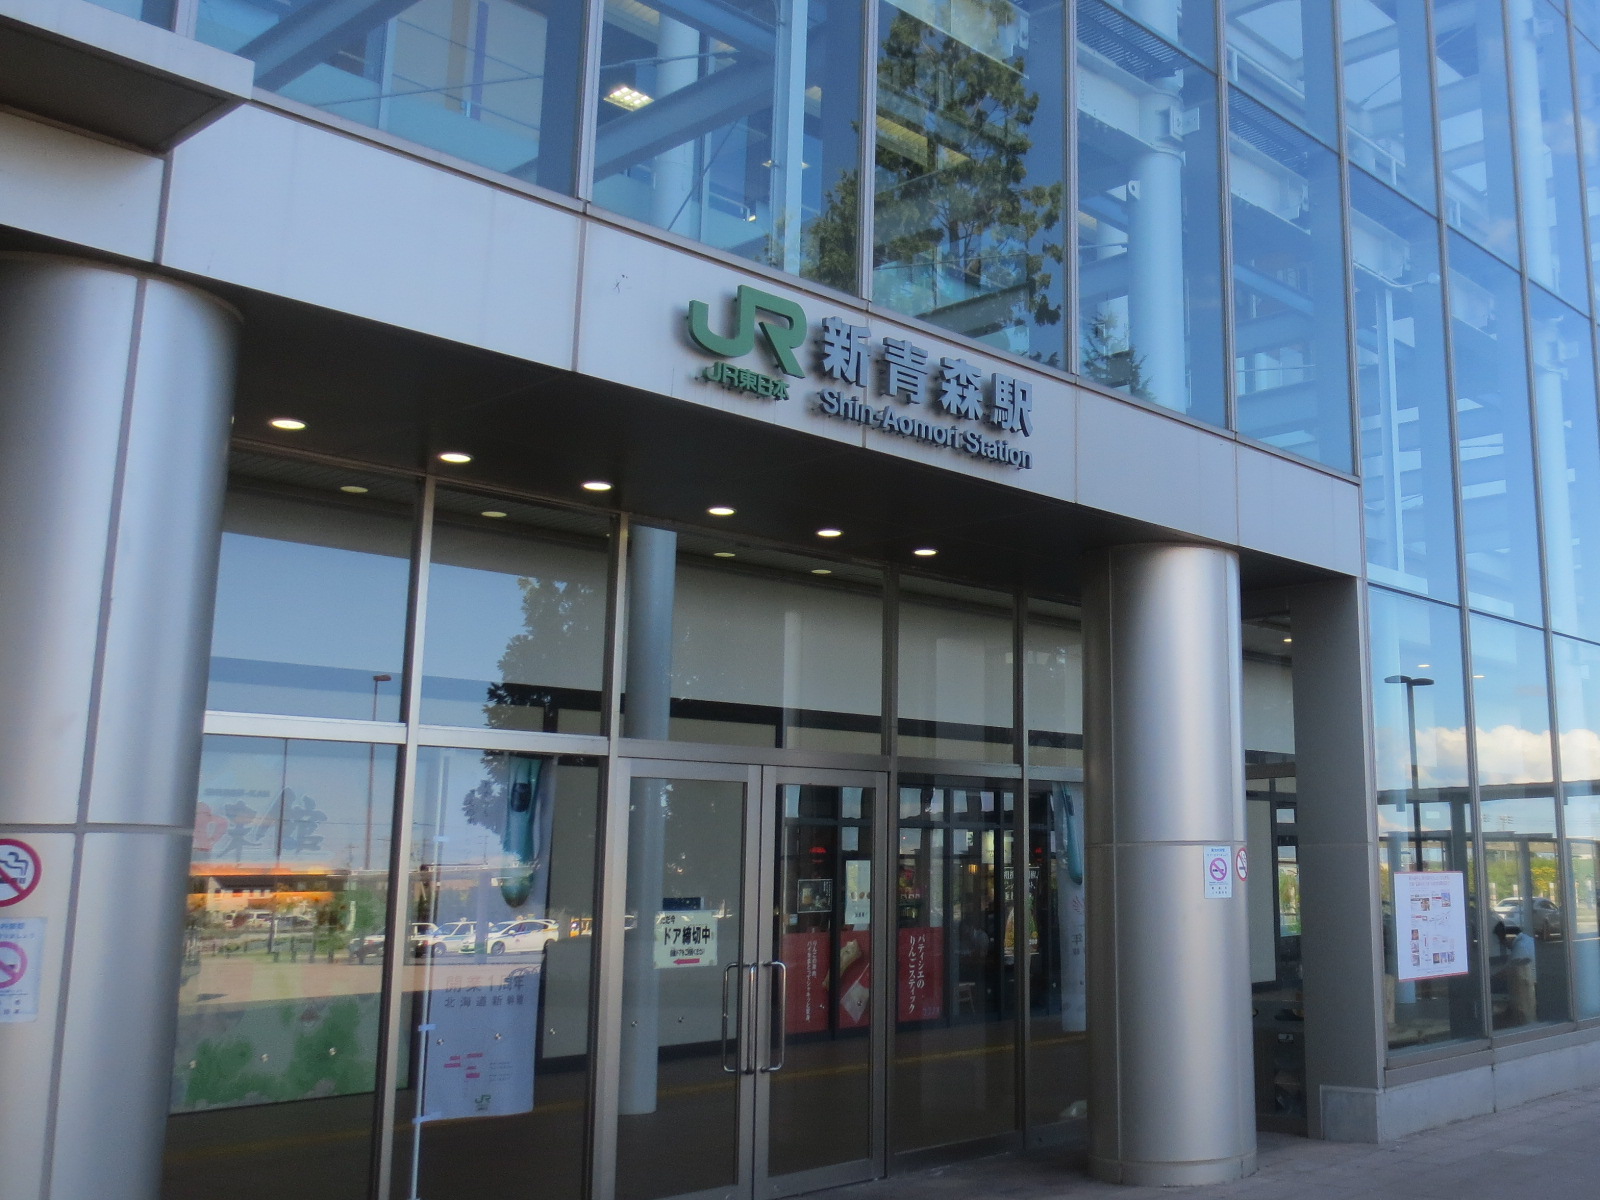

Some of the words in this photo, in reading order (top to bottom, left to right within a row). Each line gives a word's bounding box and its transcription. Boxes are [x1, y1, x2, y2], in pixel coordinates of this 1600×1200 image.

[688, 284, 807, 379] JR
[703, 360, 790, 400] JR東日本
[820, 316, 1034, 438] 新青森駅
[818, 388, 960, 448] Shin-Aomori
[960, 432, 1034, 470] Station
[663, 926, 711, 946] ドア締切中
[916, 934, 926, 989] パティシエの
[444, 992, 525, 1008] 北海道新幹線
[908, 935, 917, 1014] りんごスティック
